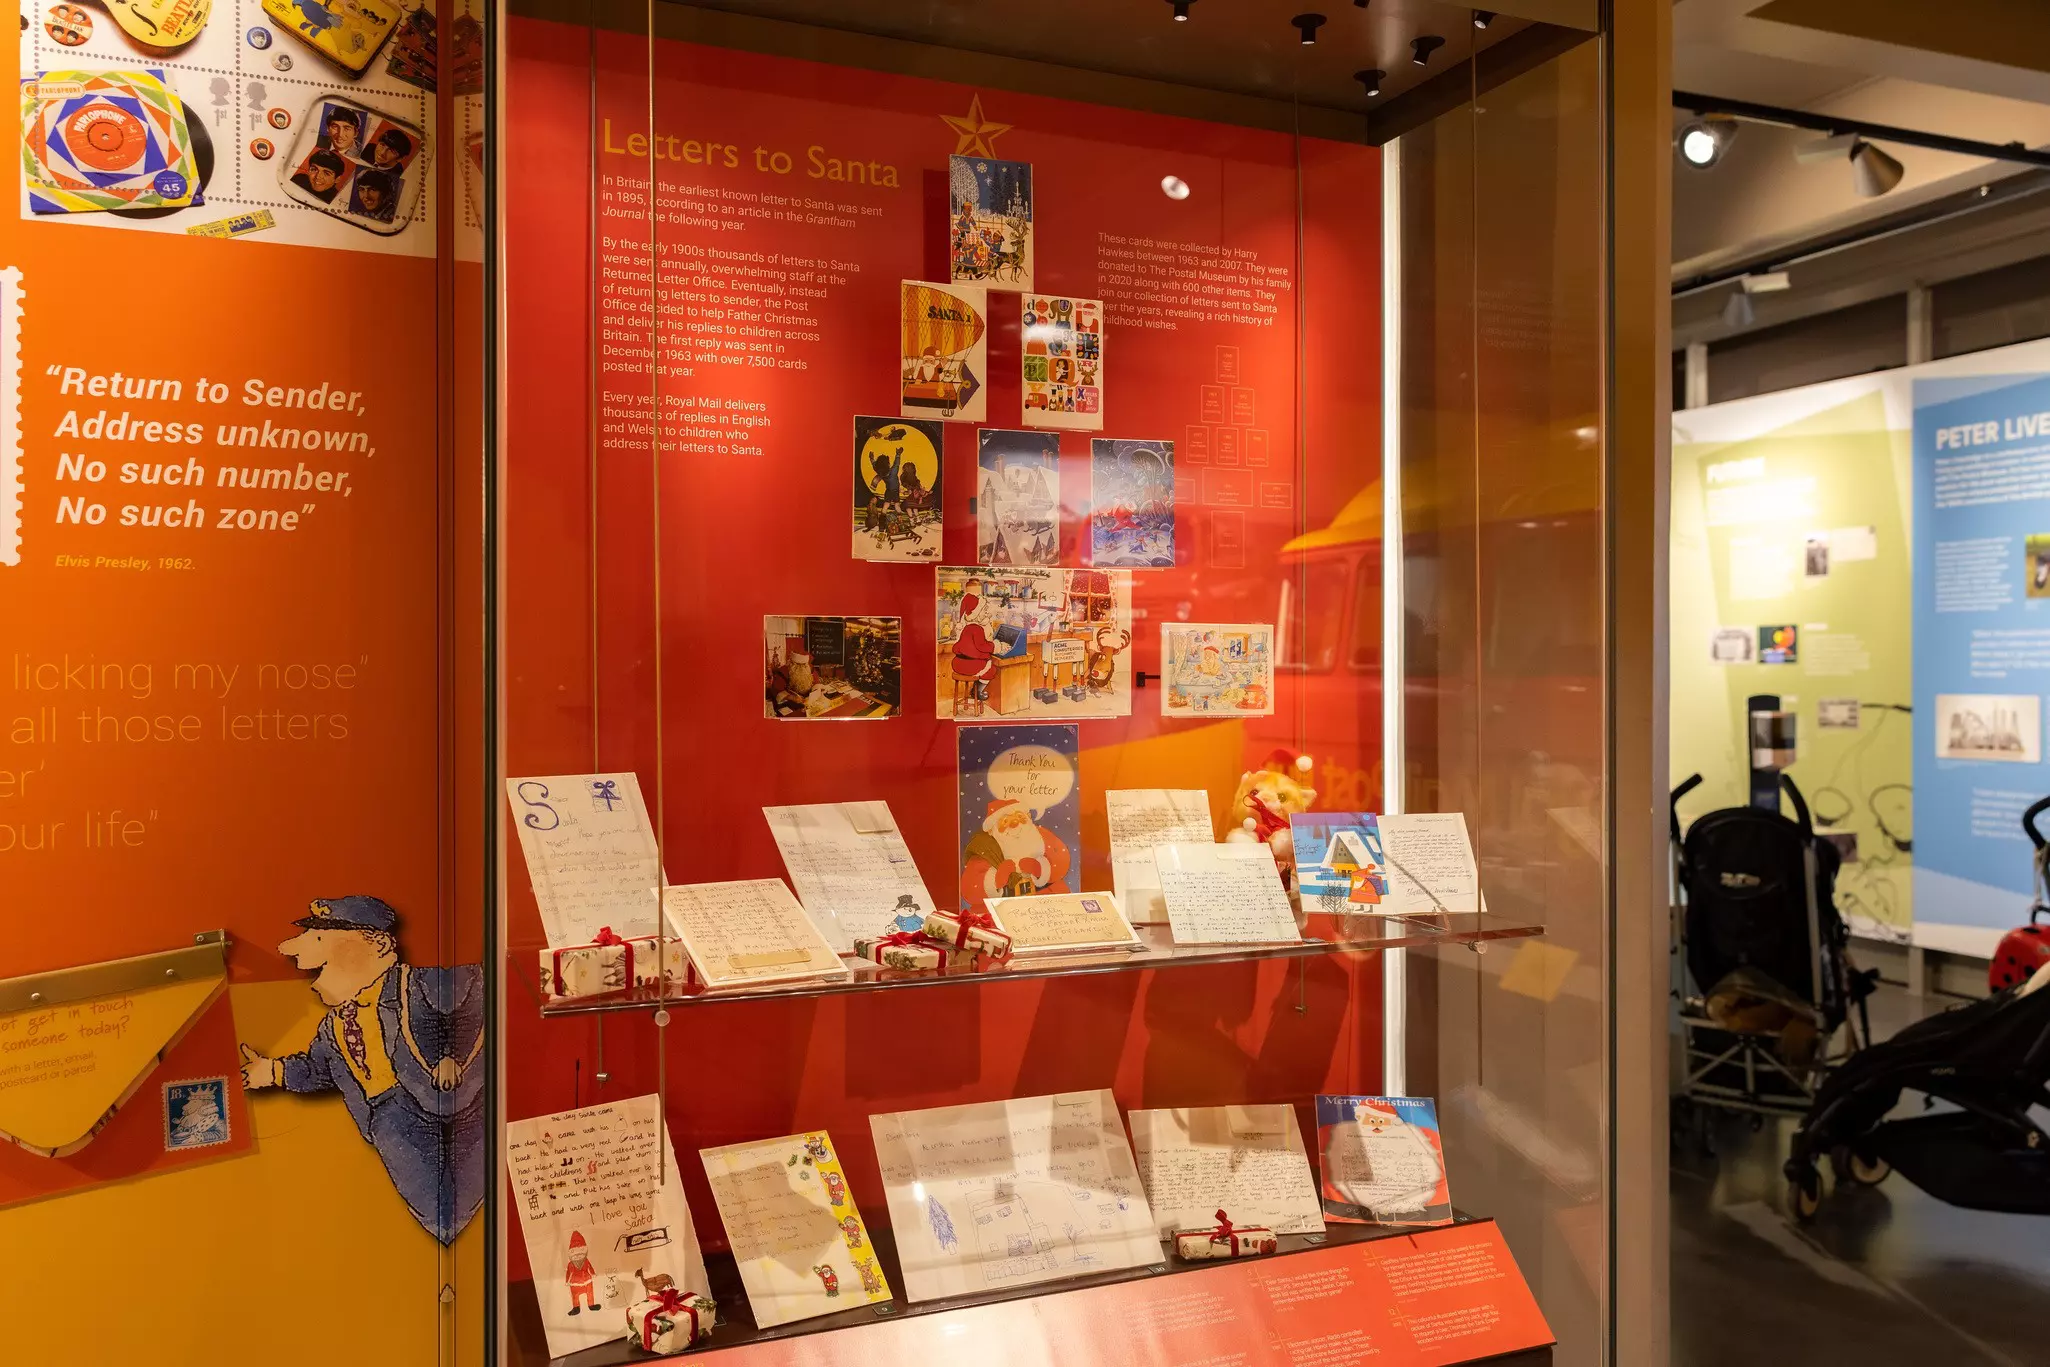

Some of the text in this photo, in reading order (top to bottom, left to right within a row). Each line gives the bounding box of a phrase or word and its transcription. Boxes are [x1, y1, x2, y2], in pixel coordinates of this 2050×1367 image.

[73, 108, 128, 133] PARLOPHONE
[214, 108, 228, 127] 1st
[248, 112, 263, 131] 1st
[604, 118, 900, 188] Letters to Santa
[162, 184, 181, 193] 45
[602, 174, 613, 186] In
[658, 180, 676, 193] the
[679, 184, 720, 198] earliest
[722, 187, 758, 203] known
[760, 192, 788, 206] letter
[790, 197, 802, 208] to
[804, 197, 835, 211] Santa
[836, 204, 858, 214] was
[860, 206, 883, 217] sent
[602, 189, 856, 228] in 1895, to an article in the Grantham
[602, 205, 746, 231] Journal following year.
[1098, 232, 1258, 261] These cards were collected by Harry
[1098, 246, 1289, 276] Hawkes between 1963 and 2007. They were
[1097, 259, 1292, 291] donated to The Postal Museum by his family
[602, 298, 818, 327] Office to help Father Christmas
[928, 305, 964, 322] SANTA
[46, 364, 367, 417] “Return to Sender,
[603, 390, 767, 412] Every year, Royal Mail delivers
[602, 406, 771, 428] thousands of replies in English
[54, 410, 377, 458] Address unknown,
[603, 437, 649, 450] address
[679, 441, 715, 454] letters
[716, 444, 729, 454] to
[731, 443, 765, 456] Santa.
[1936, 421, 1999, 450] PETER
[55, 453, 353, 497] No such number,
[55, 496, 316, 532] No such zone”
[54, 554, 197, 572] Elvis Presley, 1962.
[13, 653, 369, 699] licking my nose”
[11, 706, 349, 744] all those letters
[1008, 752, 1056, 768] Thank You
[1026, 768, 1041, 781] for
[1003, 782, 1059, 799] your letter
[86, 809, 159, 849] life”
[0, 996, 134, 1036] ot get in touch
[1, 1014, 130, 1054] someone today?
[0, 1064, 22, 1076] with
[24, 1063, 31, 1072] a
[33, 1058, 64, 1070] letter,
[0, 1062, 97, 1090] postcard or parcel
[597, 1107, 614, 1115] came
[1324, 1096, 1426, 1108] Merry Christmas
[580, 1142, 596, 1150] very
[549, 1167, 583, 1179] childrens
[529, 1211, 548, 1221] back
[601, 1209, 623, 1222] love
[628, 1203, 648, 1220] you
[624, 1213, 655, 1231] Santa
